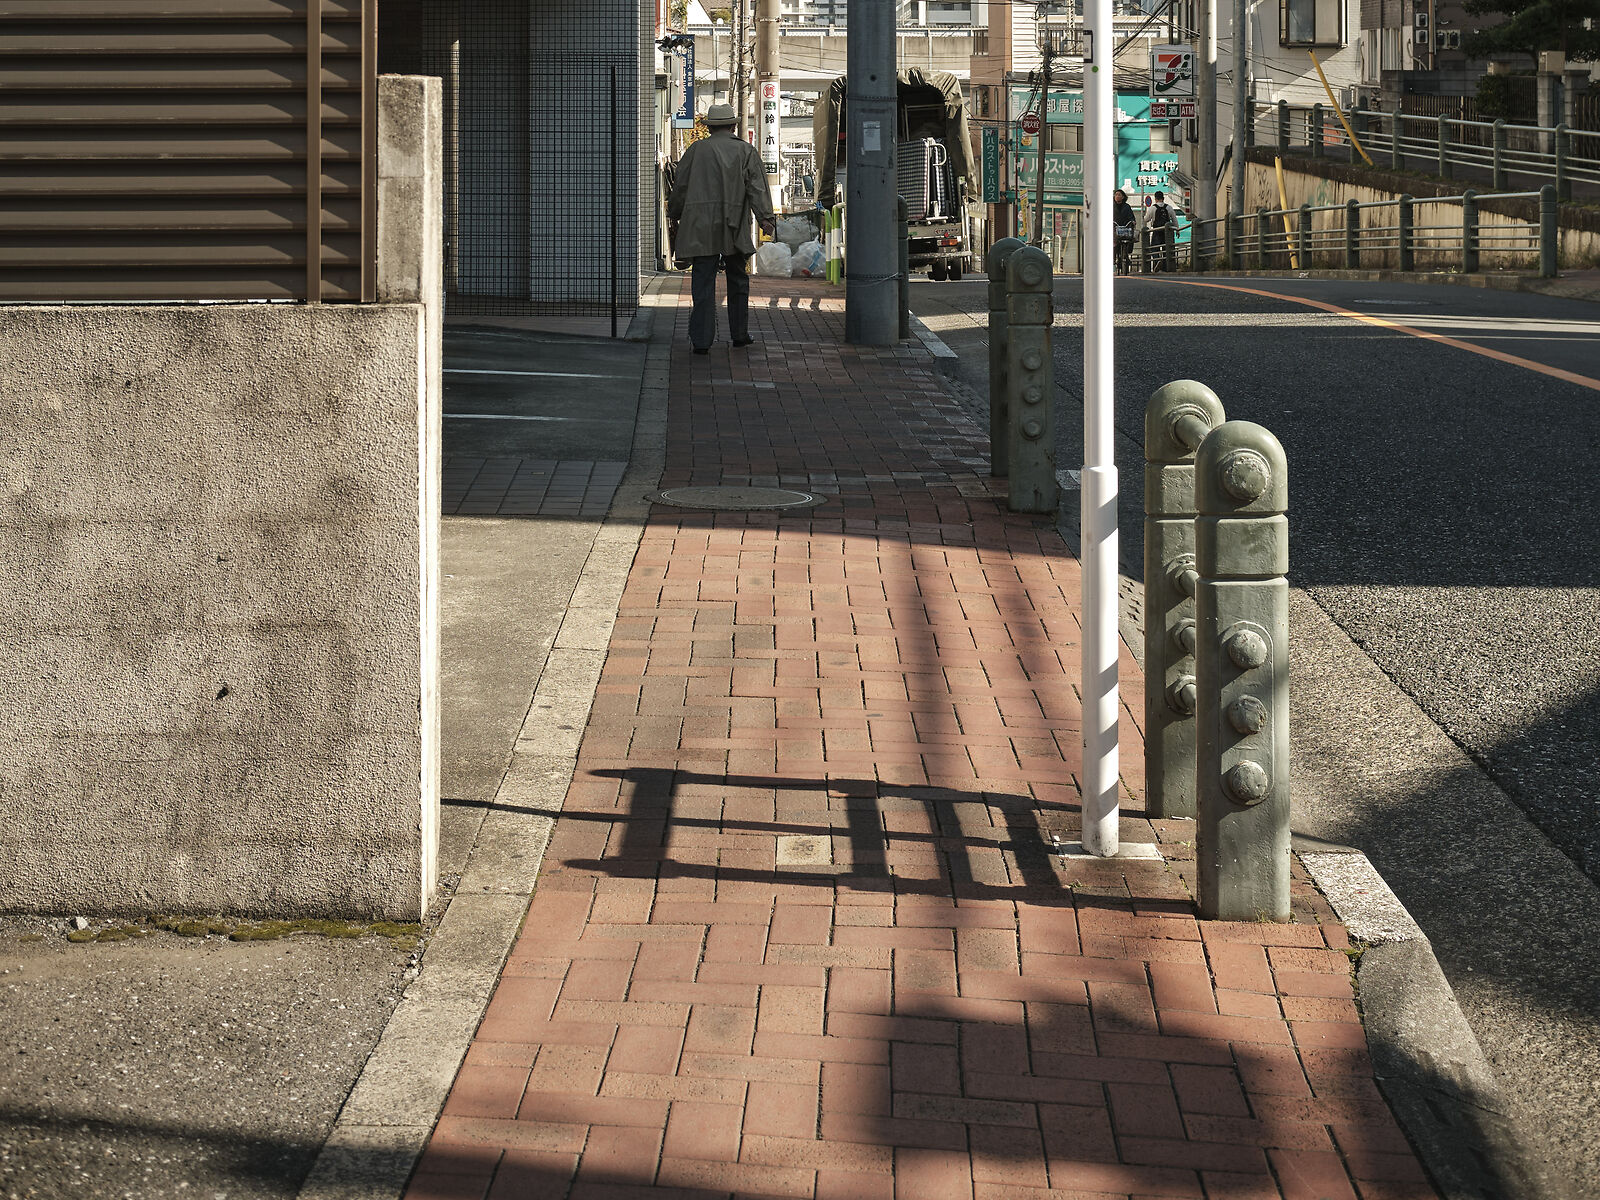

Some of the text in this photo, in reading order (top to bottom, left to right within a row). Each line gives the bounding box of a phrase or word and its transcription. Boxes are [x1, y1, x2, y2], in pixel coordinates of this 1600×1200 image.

[1181, 106, 1195, 115] ATM
[1024, 120, 1040, 129] 消火栓
[986, 138, 996, 200] ハウス・トゥ・ハウス
